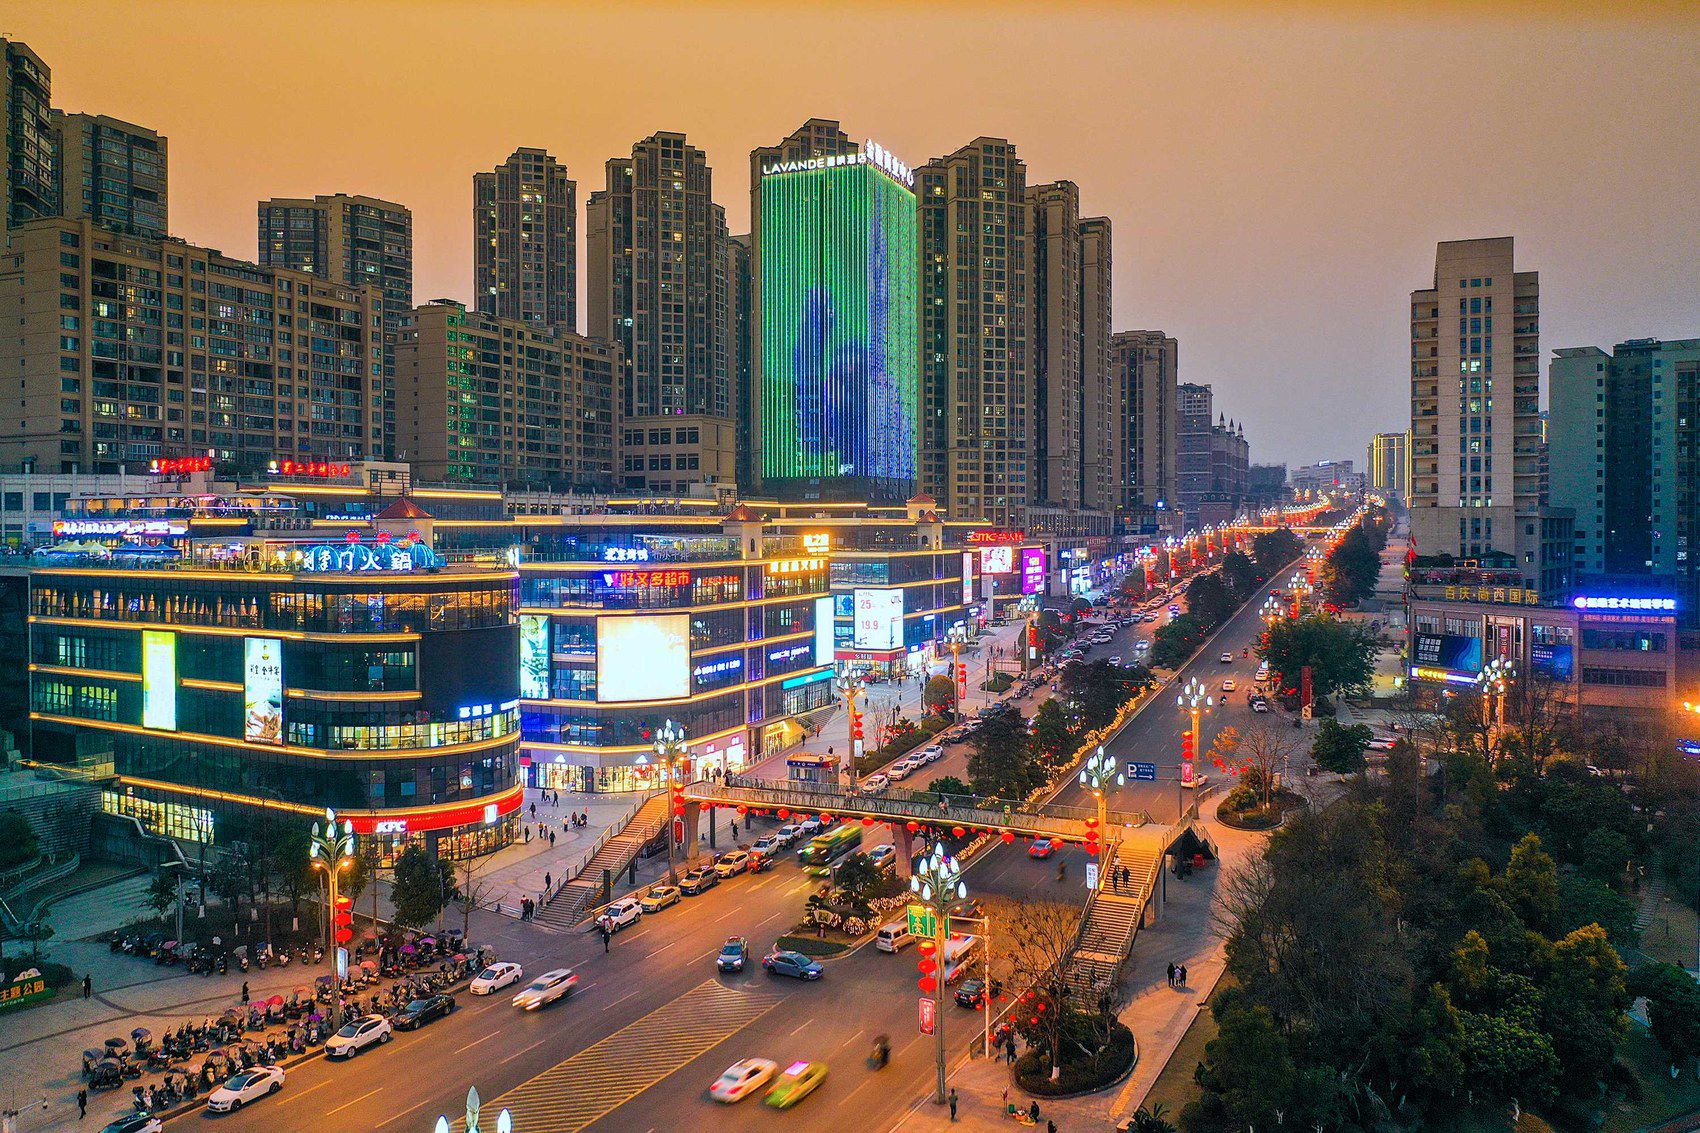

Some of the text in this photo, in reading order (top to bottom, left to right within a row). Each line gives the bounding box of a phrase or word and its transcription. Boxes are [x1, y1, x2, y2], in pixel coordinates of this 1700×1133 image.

[763, 158, 825, 175] LAVANDE
[620, 571, 690, 587] 好又多超市
[860, 599, 872, 610] 25
[861, 620, 879, 630] 19.9
[1128, 764, 1137, 778] P
[375, 821, 407, 833] KFC
